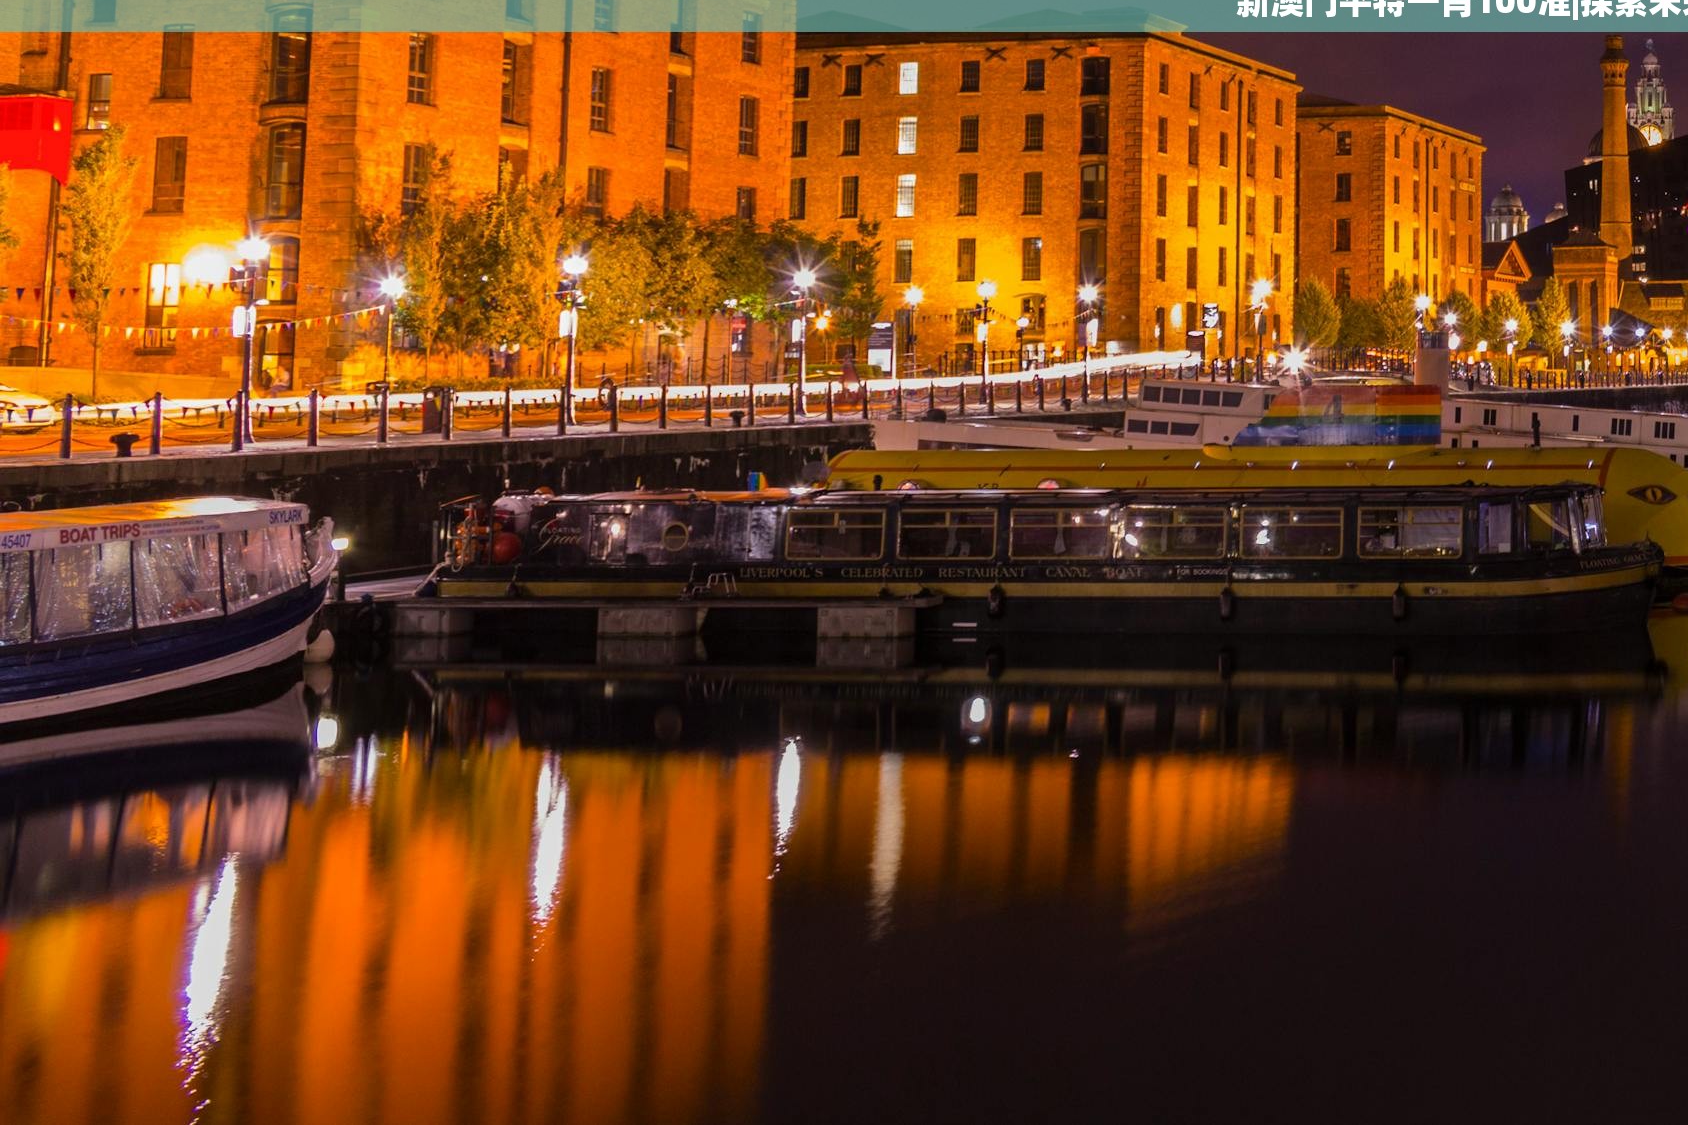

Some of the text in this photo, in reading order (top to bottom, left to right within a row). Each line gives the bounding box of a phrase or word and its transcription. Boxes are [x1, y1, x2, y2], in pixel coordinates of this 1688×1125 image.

[269, 509, 302, 524] SKYLARK
[60, 527, 98, 544] BOAT
[101, 523, 140, 540] TRIPS
[740, 567, 1144, 578] LIVERPOOL'S CELEBRATED RESTAURANT CANAL BOAT
[1176, 567, 1190, 575] FOR
[1193, 567, 1229, 575] BOOKINGS
